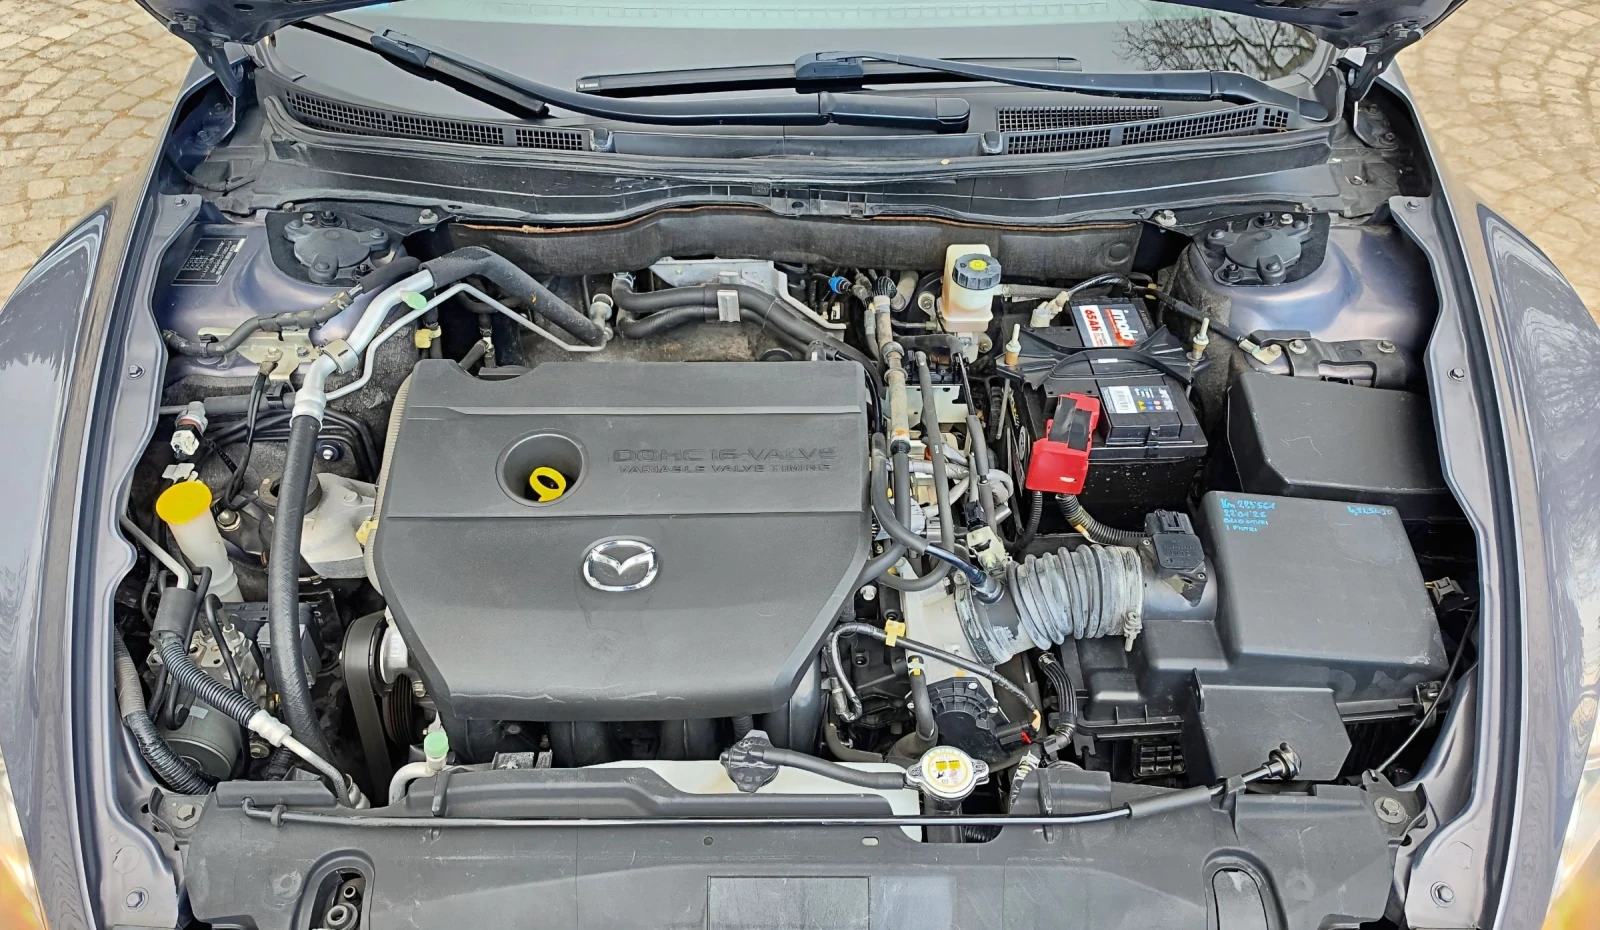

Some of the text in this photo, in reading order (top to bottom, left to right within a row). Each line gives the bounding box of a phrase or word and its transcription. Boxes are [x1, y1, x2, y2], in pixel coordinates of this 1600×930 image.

[1084, 309, 1102, 332] 65Ah
[612, 448, 838, 462] DOHC 16-VALVE
[619, 463, 831, 474] VARIABLE VALVE TIMING
